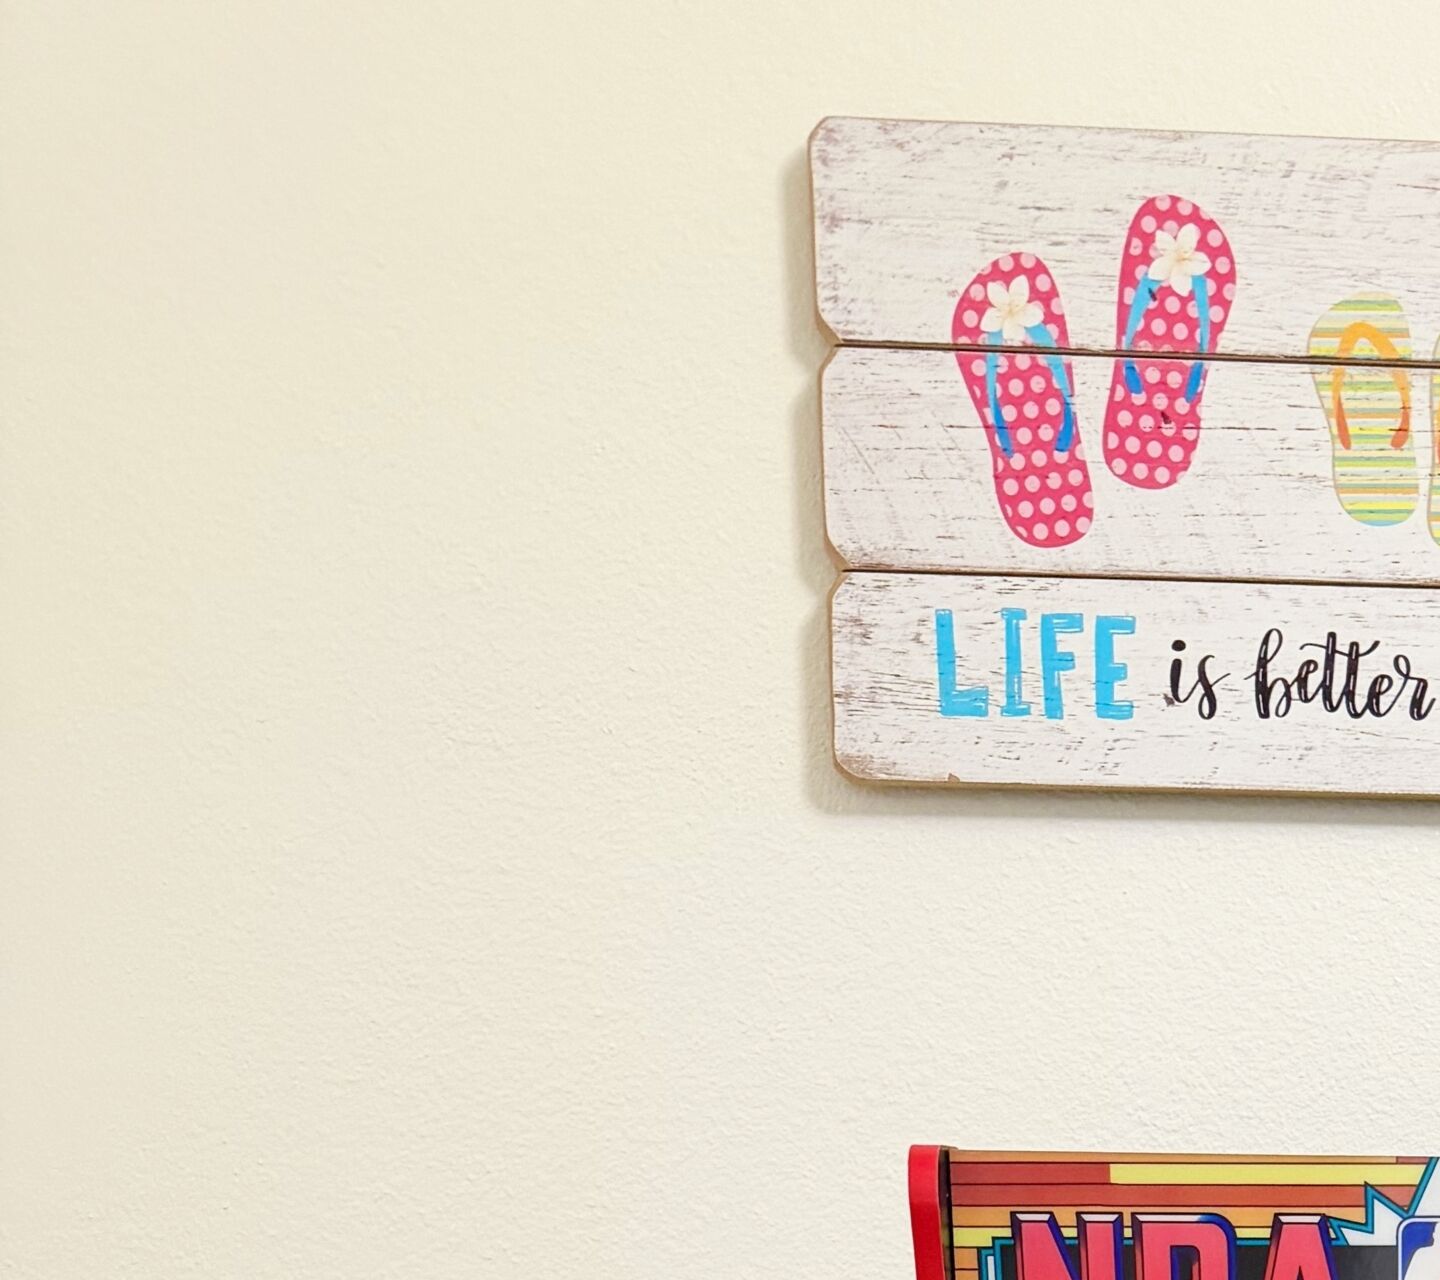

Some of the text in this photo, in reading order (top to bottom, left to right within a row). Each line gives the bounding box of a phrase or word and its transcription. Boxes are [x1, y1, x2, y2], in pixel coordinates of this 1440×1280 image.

[934, 607, 1136, 720] LIFE
[1165, 639, 1231, 720] is
[1244, 628, 1436, 721] better
